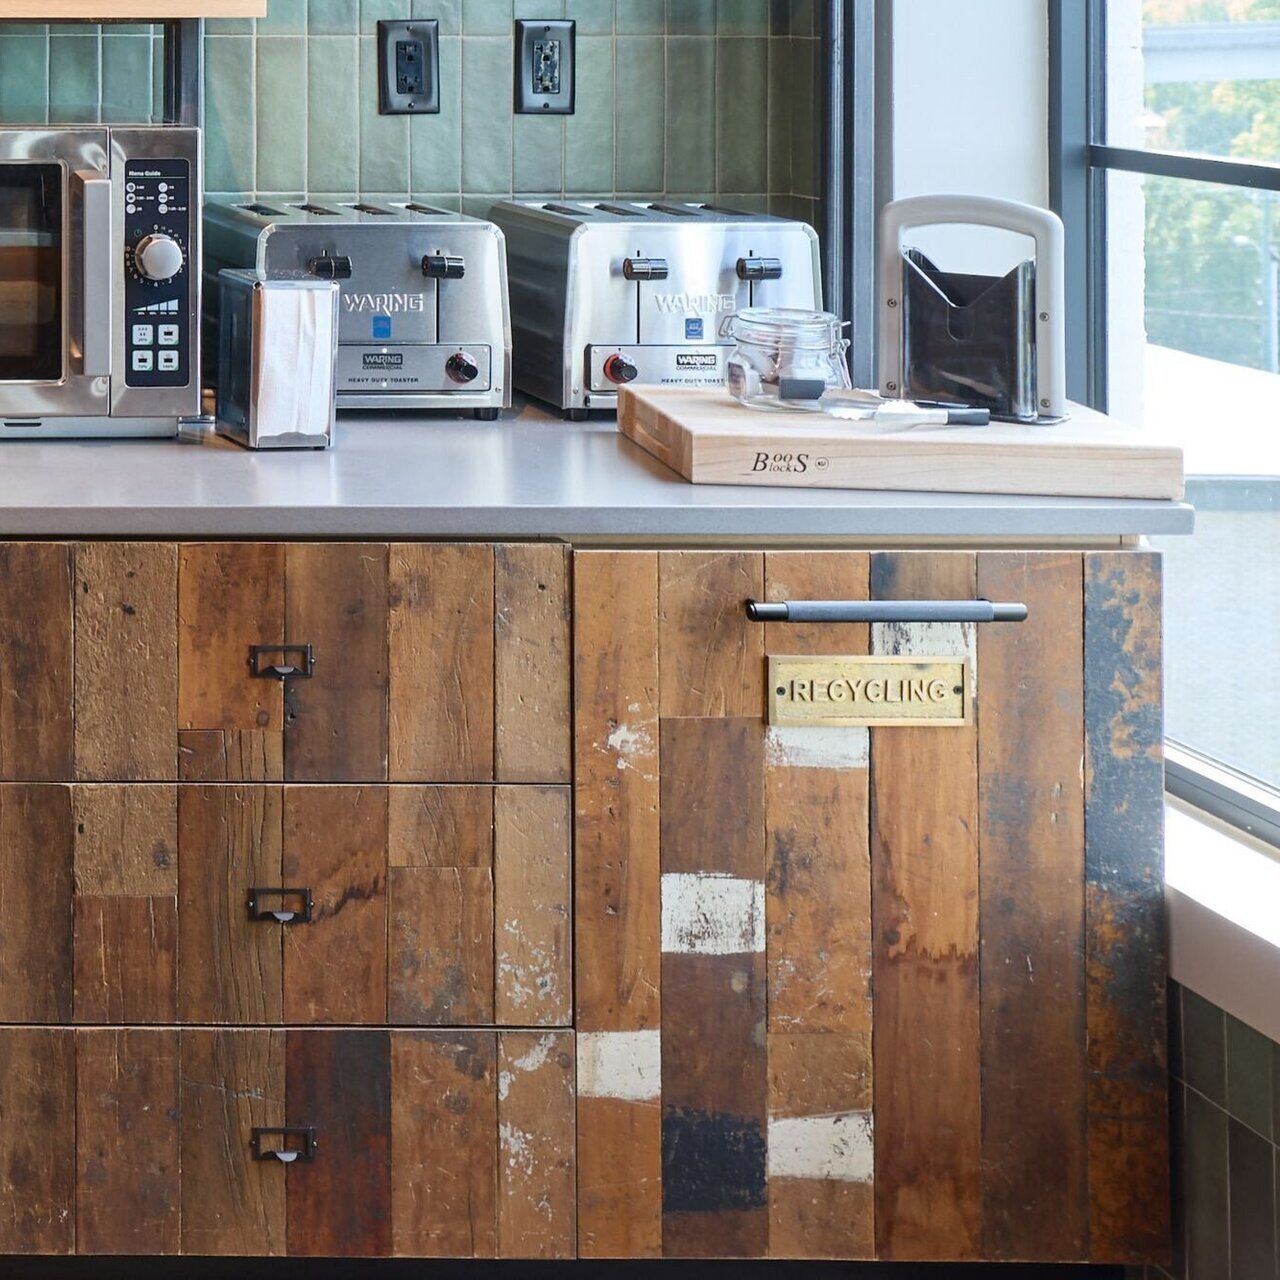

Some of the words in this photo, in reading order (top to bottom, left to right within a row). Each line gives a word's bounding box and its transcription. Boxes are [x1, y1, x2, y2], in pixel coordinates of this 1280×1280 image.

[344, 293, 424, 317] WARING
[654, 292, 736, 316] WARING
[364, 354, 403, 365] WARING
[677, 354, 717, 366] WARING
[789, 678, 948, 704] RECYCLING
